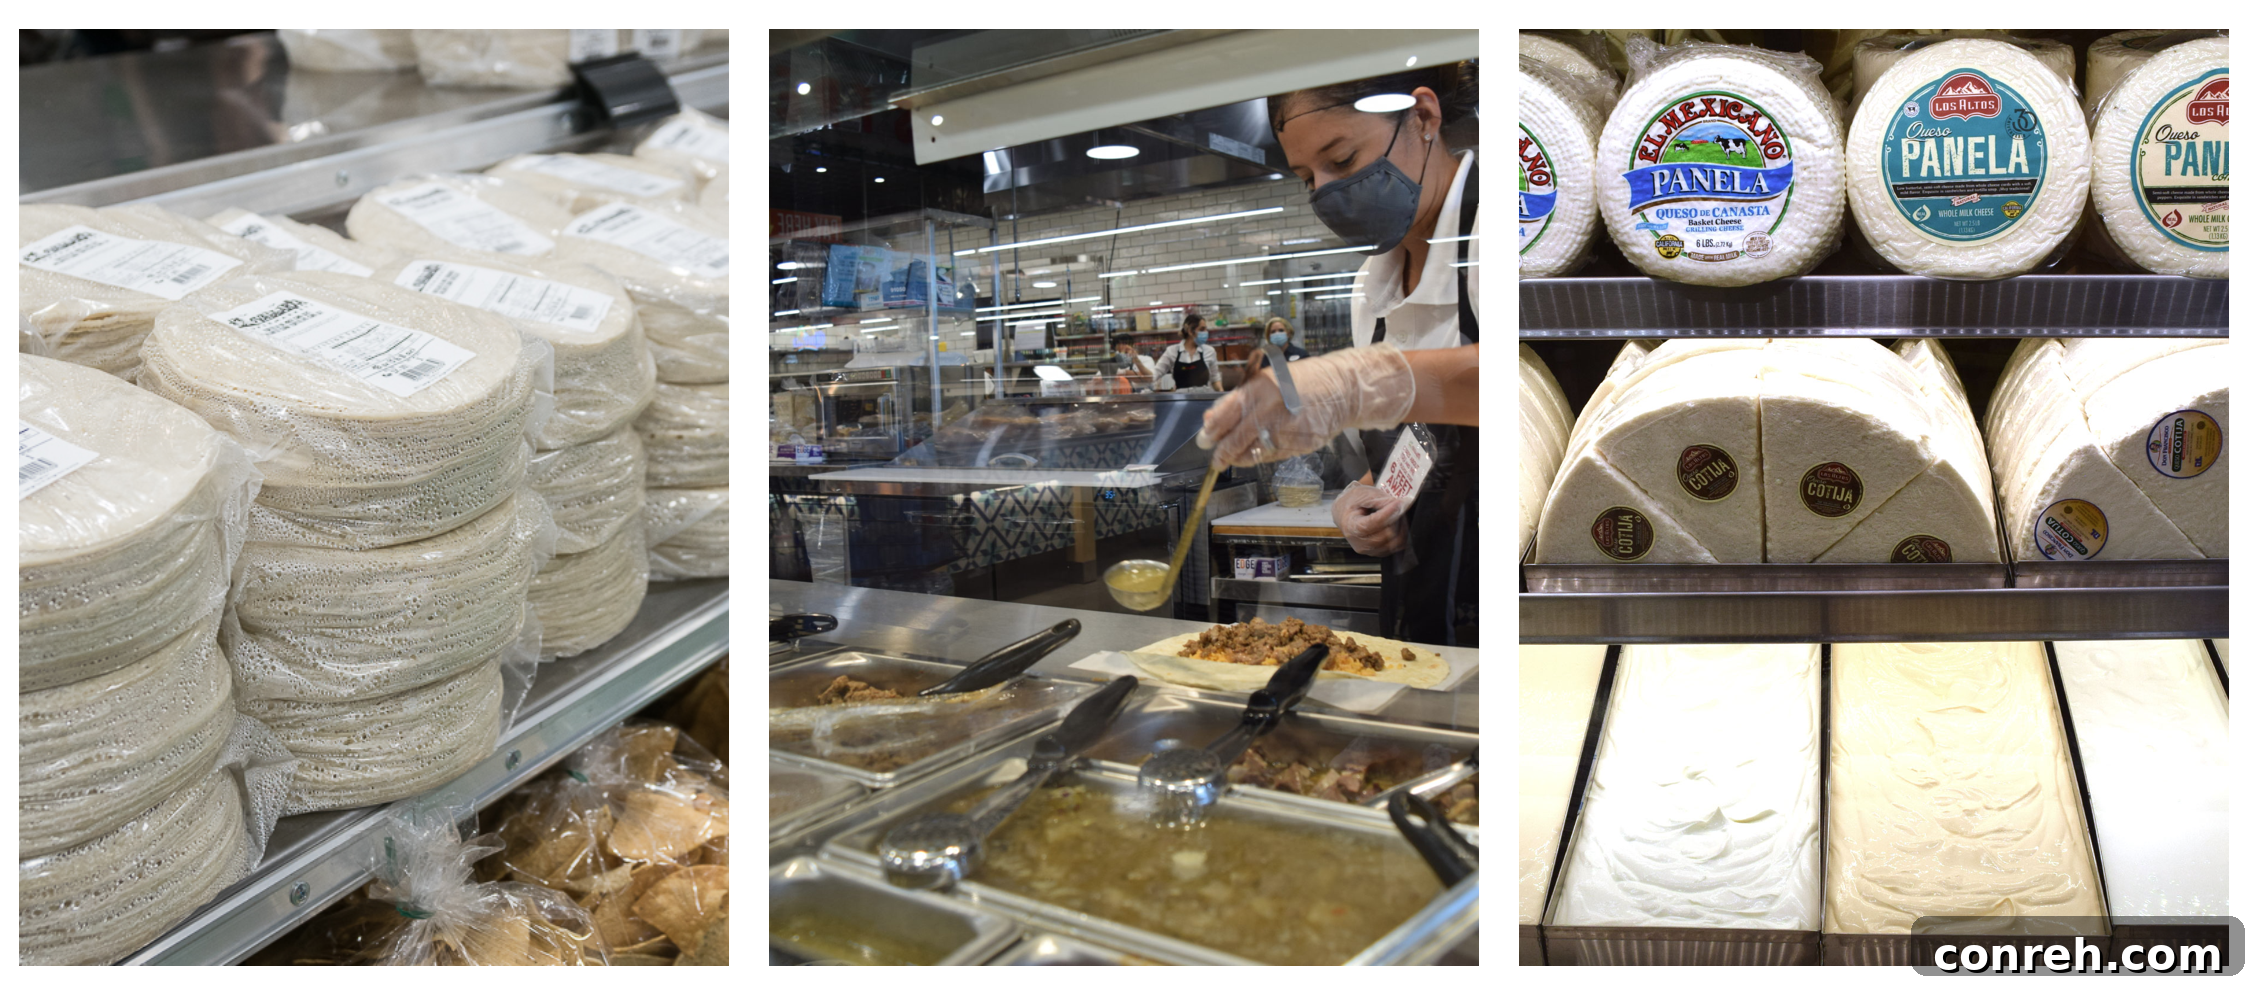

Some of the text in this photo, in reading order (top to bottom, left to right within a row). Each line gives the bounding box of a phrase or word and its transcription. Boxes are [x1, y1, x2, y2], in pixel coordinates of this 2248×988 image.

[1935, 99, 1995, 112] LOS ALTOS
[2192, 107, 2214, 117] LOS
[1638, 98, 1785, 163] EL MEXICANO
[1906, 120, 1953, 140] Queso
[2155, 123, 2200, 142] Queso
[1901, 134, 2030, 178] PANELA
[1650, 166, 1771, 198] PANELA
[1655, 207, 1699, 221] QUESO
[1711, 205, 1771, 218] CANASTA
[1938, 207, 1994, 218] WHOLE MILK CHEESE
[2188, 214, 2210, 223] WHOLE
[2210, 214, 2226, 223] MILK
[1685, 224, 1744, 233] GRILLING CHEESE
[1688, 218, 1742, 227] Basket Cheese
[1655, 240, 1683, 248] CALIFORNIA
[1696, 239, 1701, 248] 6
[1702, 238, 1715, 248] LBS.
[1690, 251, 1705, 260] MADE
[1725, 251, 1738, 259] MILK
[2174, 419, 2184, 454] COTIJA
[1390, 461, 1397, 474] 6
[1688, 458, 1730, 491] COTIJA
[1807, 481, 1853, 503] COTIJA
[1618, 514, 1634, 554] COTIJA
[2047, 517, 2074, 544] COTIJA
[1236, 558, 1256, 570] EDGE
